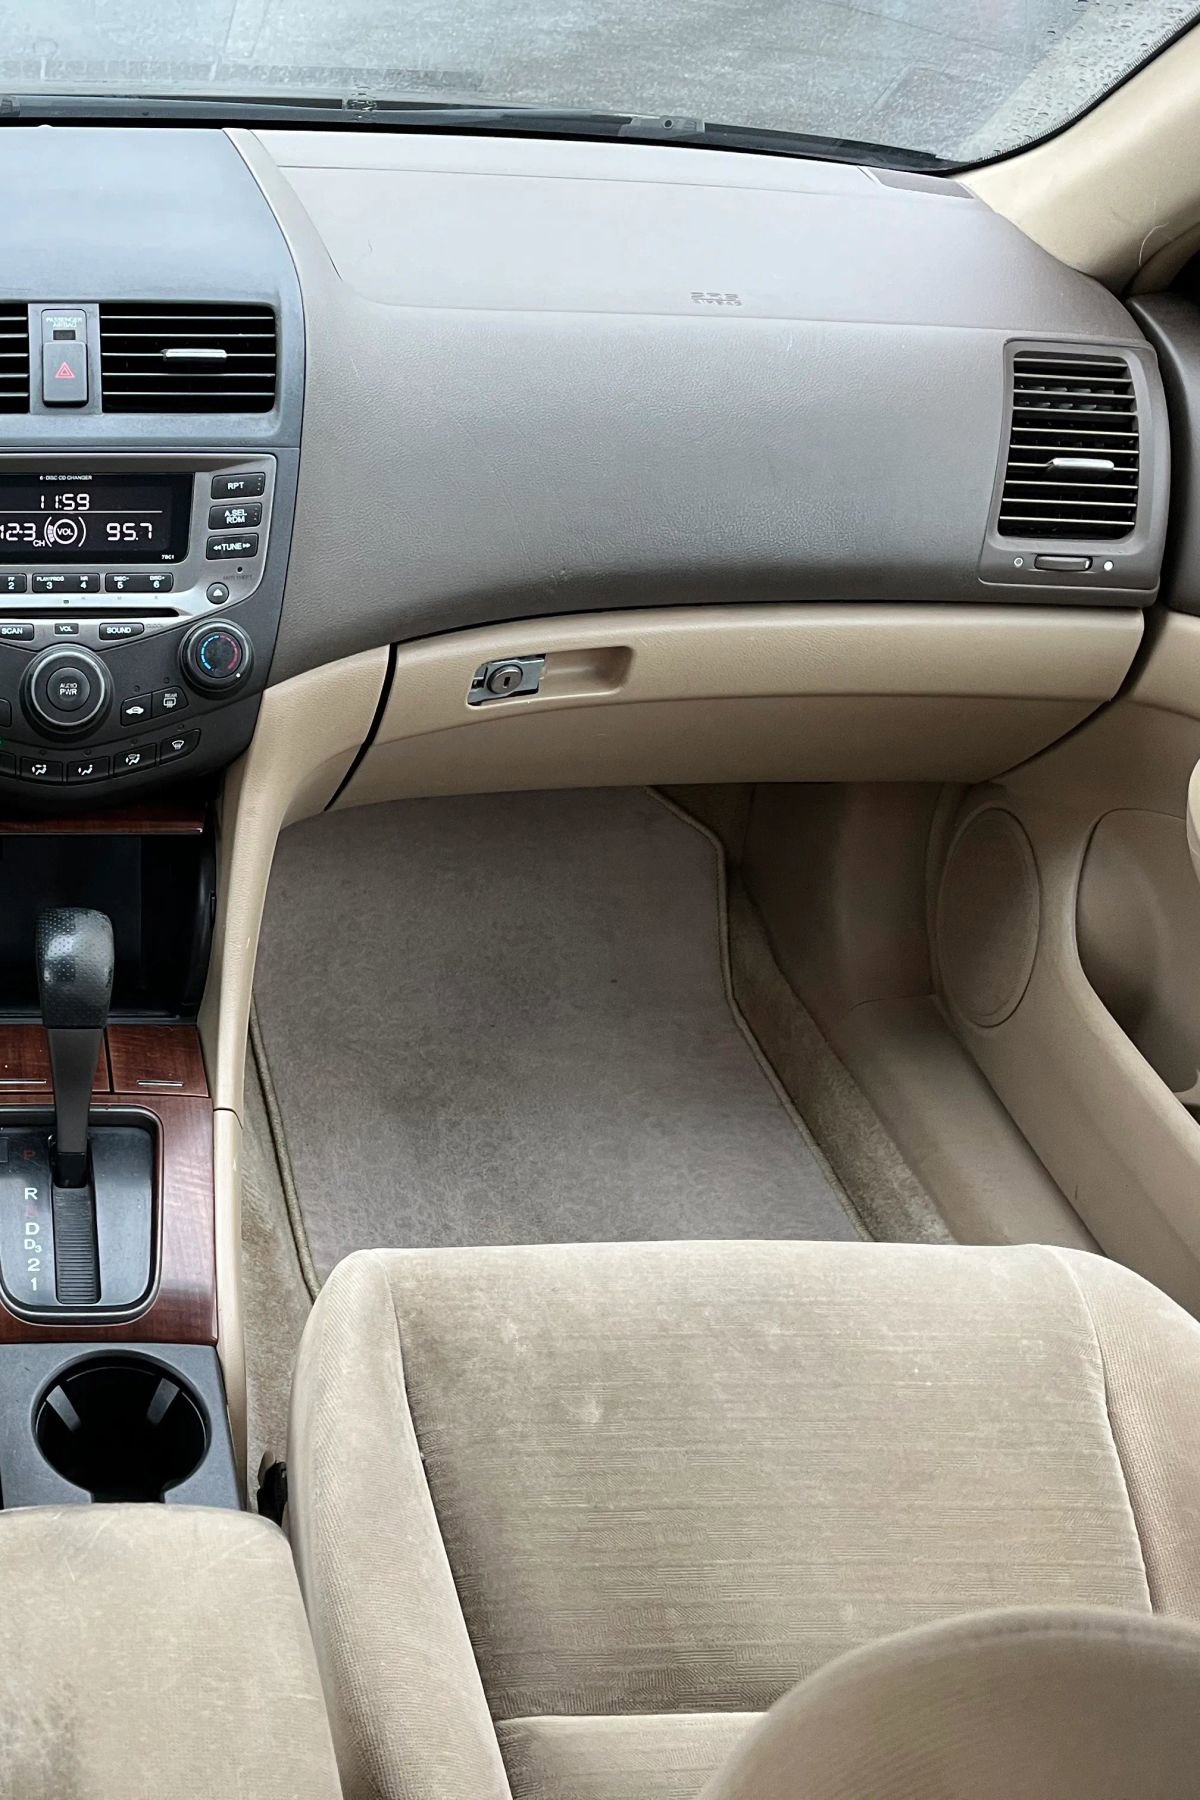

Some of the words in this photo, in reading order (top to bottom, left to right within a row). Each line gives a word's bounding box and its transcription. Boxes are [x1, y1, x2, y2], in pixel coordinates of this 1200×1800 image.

[227, 482, 244, 490] RPT
[40, 493, 90, 511] 11:59
[226, 516, 246, 524] RDM
[57, 528, 74, 536] VOL
[106, 522, 153, 541] 95.7
[32, 539, 46, 547] CH
[221, 543, 243, 551] TUNE
[7, 582, 15, 590] 2
[46, 582, 53, 590] 3
[80, 581, 87, 589] 4
[117, 581, 124, 589] 5
[153, 580, 160, 588] 6
[1, 627, 23, 635] SCAN
[59, 688, 78, 696] PWR
[24, 1187, 38, 1200] R
[25, 1222, 40, 1236] D
[27, 1258, 41, 1272] 2
[30, 1277, 38, 1291] 1
